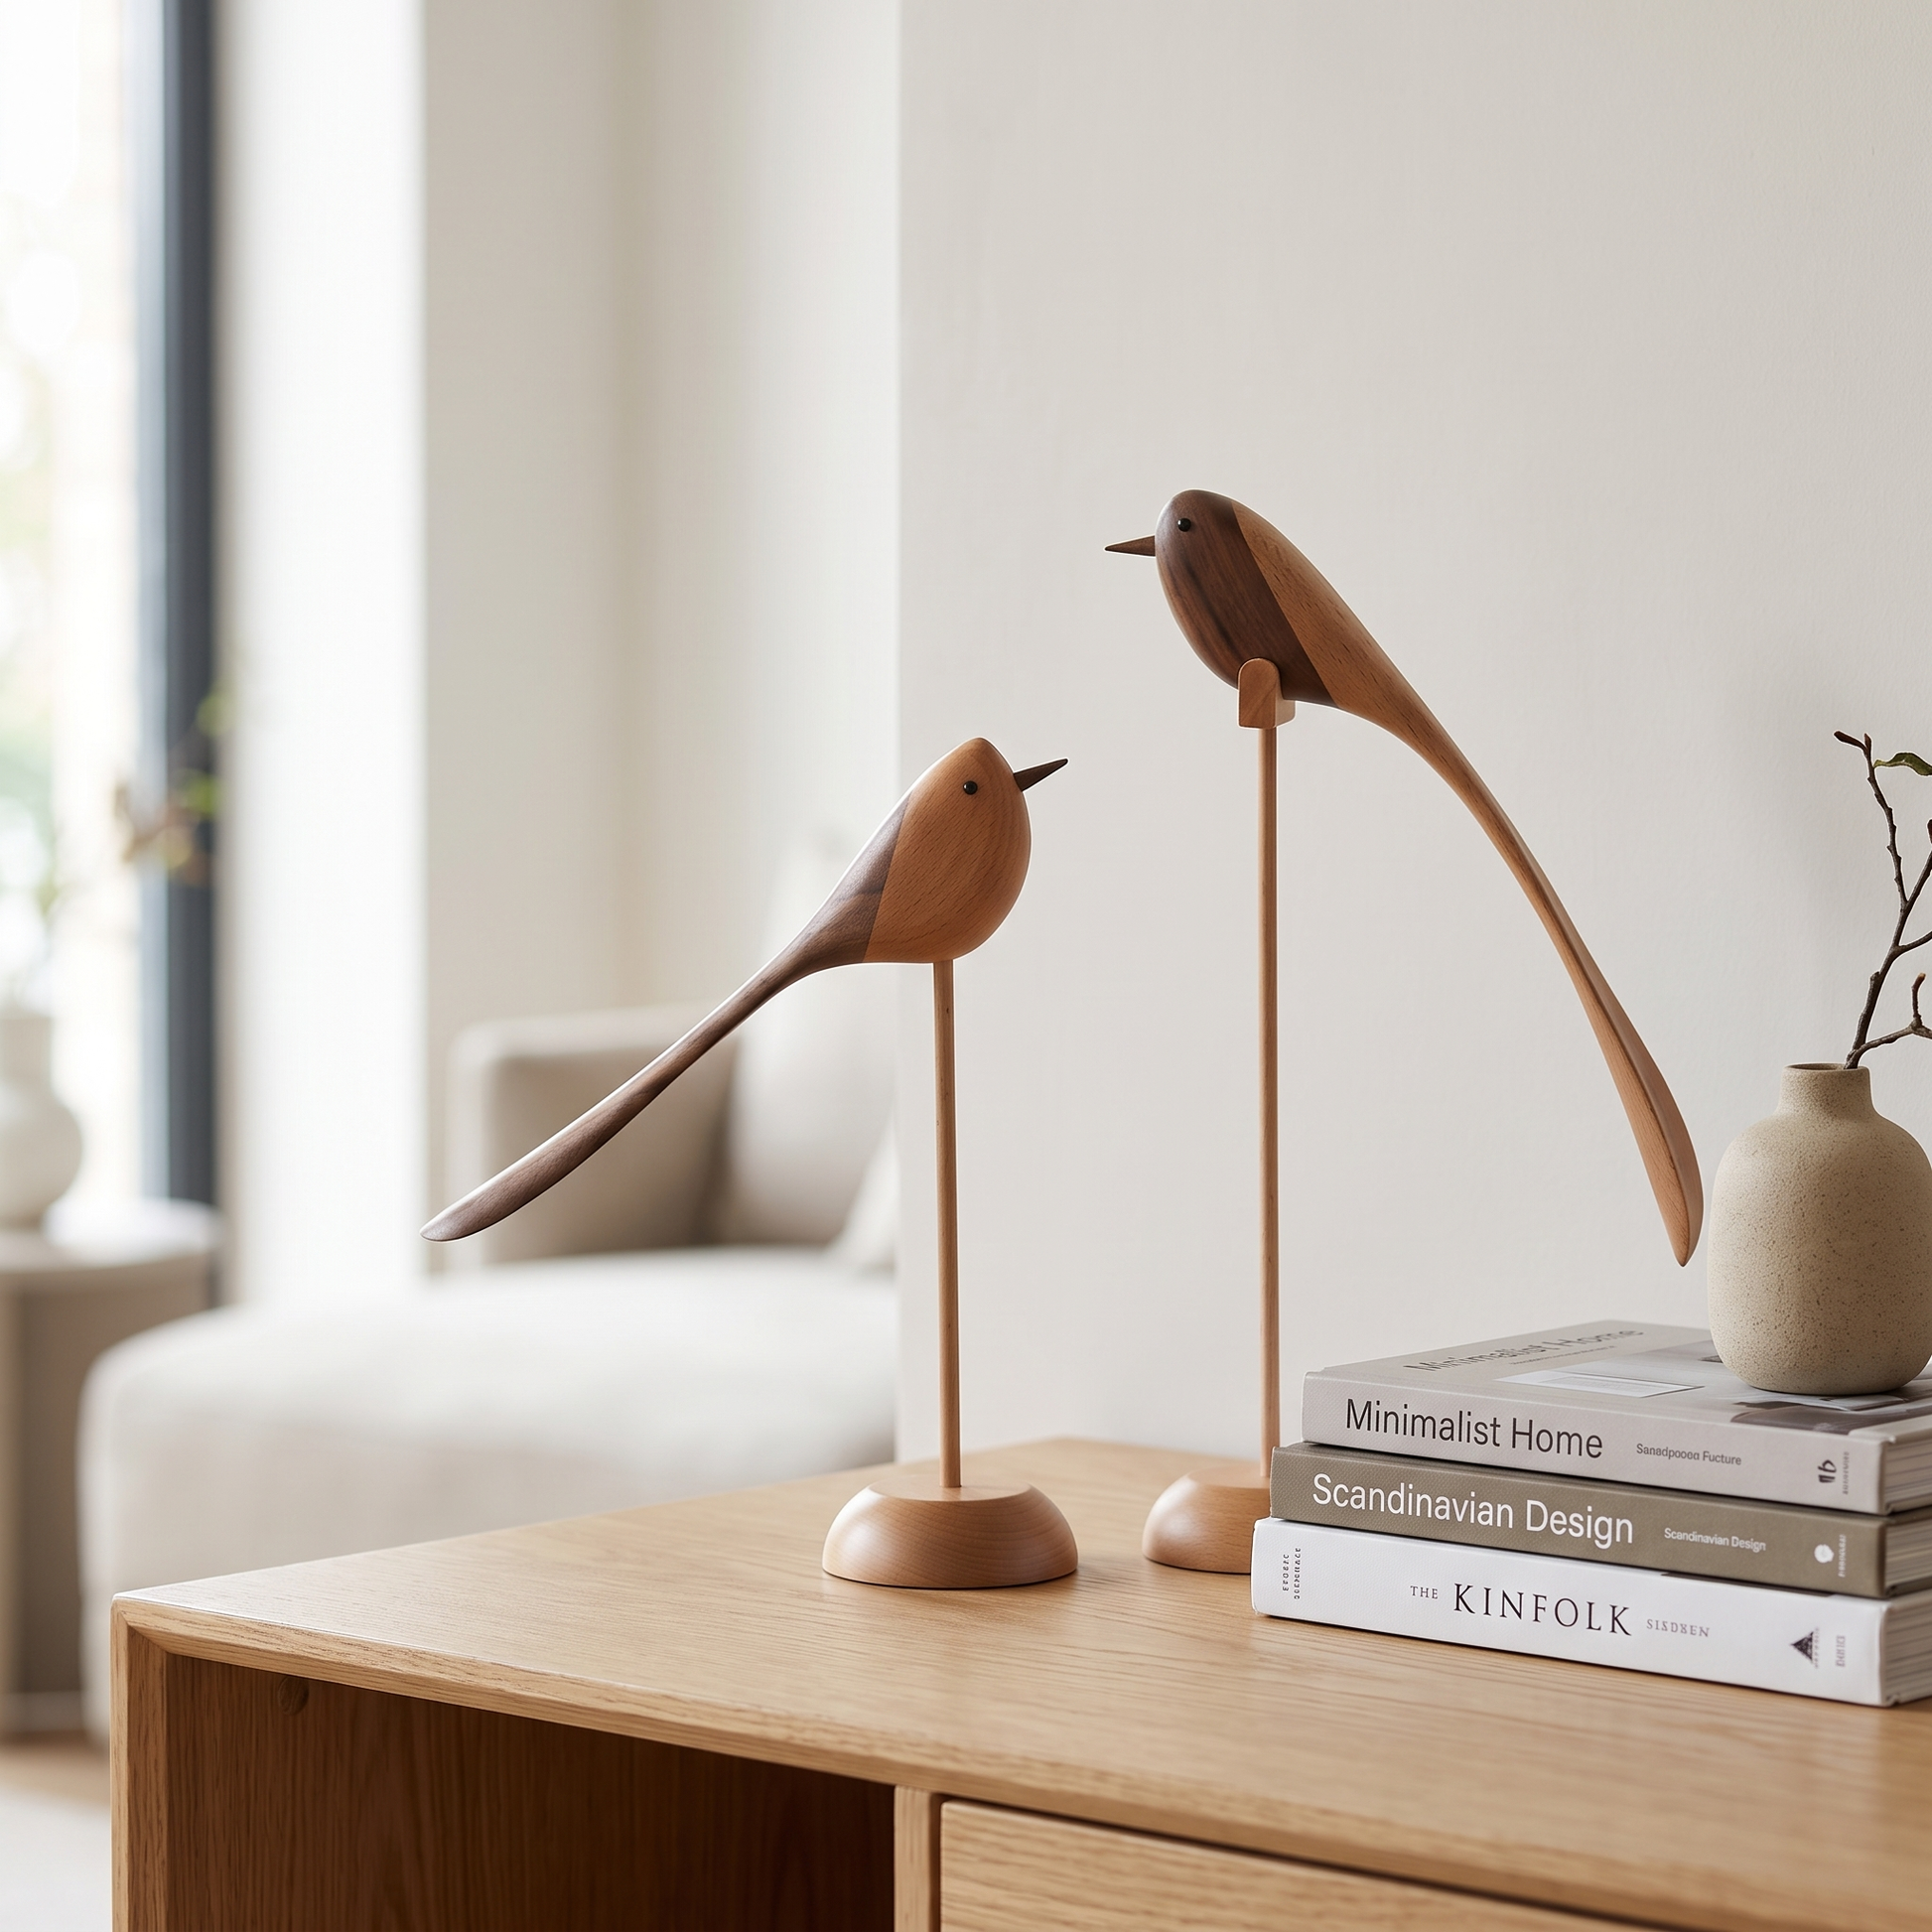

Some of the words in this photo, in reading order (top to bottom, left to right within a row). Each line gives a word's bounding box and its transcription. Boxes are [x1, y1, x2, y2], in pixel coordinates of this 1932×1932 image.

[1346, 1398, 1501, 1448] Minimalist
[1511, 1418, 1603, 1459] Home
[1702, 1449, 1742, 1466] Fucture
[1312, 1473, 1513, 1530] Scandinavian
[1526, 1499, 1633, 1550] Design
[1664, 1527, 1729, 1547] Scandinavian
[1730, 1535, 1767, 1554] Design
[1410, 1585, 1439, 1600] THE
[1452, 1583, 1632, 1636] KINFOLK
